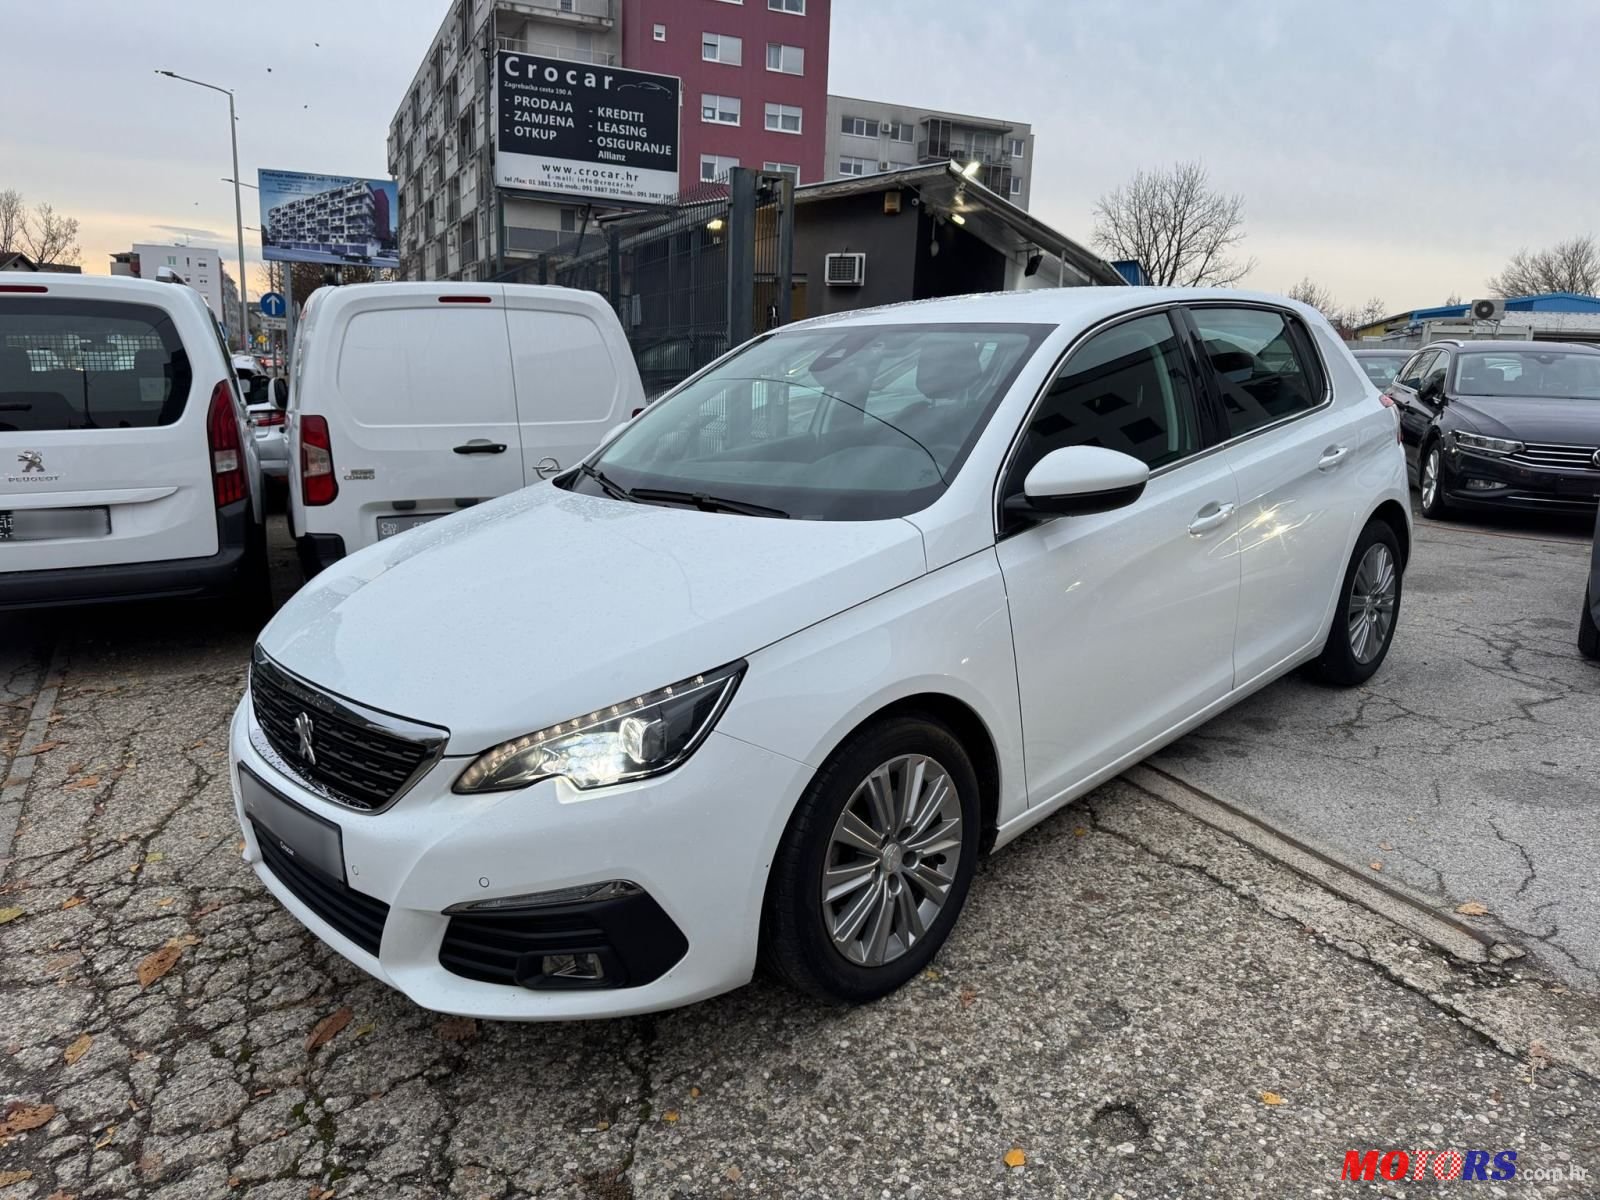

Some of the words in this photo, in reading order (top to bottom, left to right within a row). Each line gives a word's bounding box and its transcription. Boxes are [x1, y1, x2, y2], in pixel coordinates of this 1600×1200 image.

[504, 56, 614, 89] Crocar
[514, 95, 573, 113] PRODAJA
[514, 110, 575, 128] ZAMJENA
[597, 106, 644, 123] KREDITI
[514, 125, 557, 141] OTKUP
[597, 121, 648, 138] LEASING
[597, 136, 672, 155] OSIGURANJE
[598, 150, 626, 162] Allianz
[542, 164, 639, 182] www.crocar.hr
[8, 475, 60, 483] PEUGEOT
